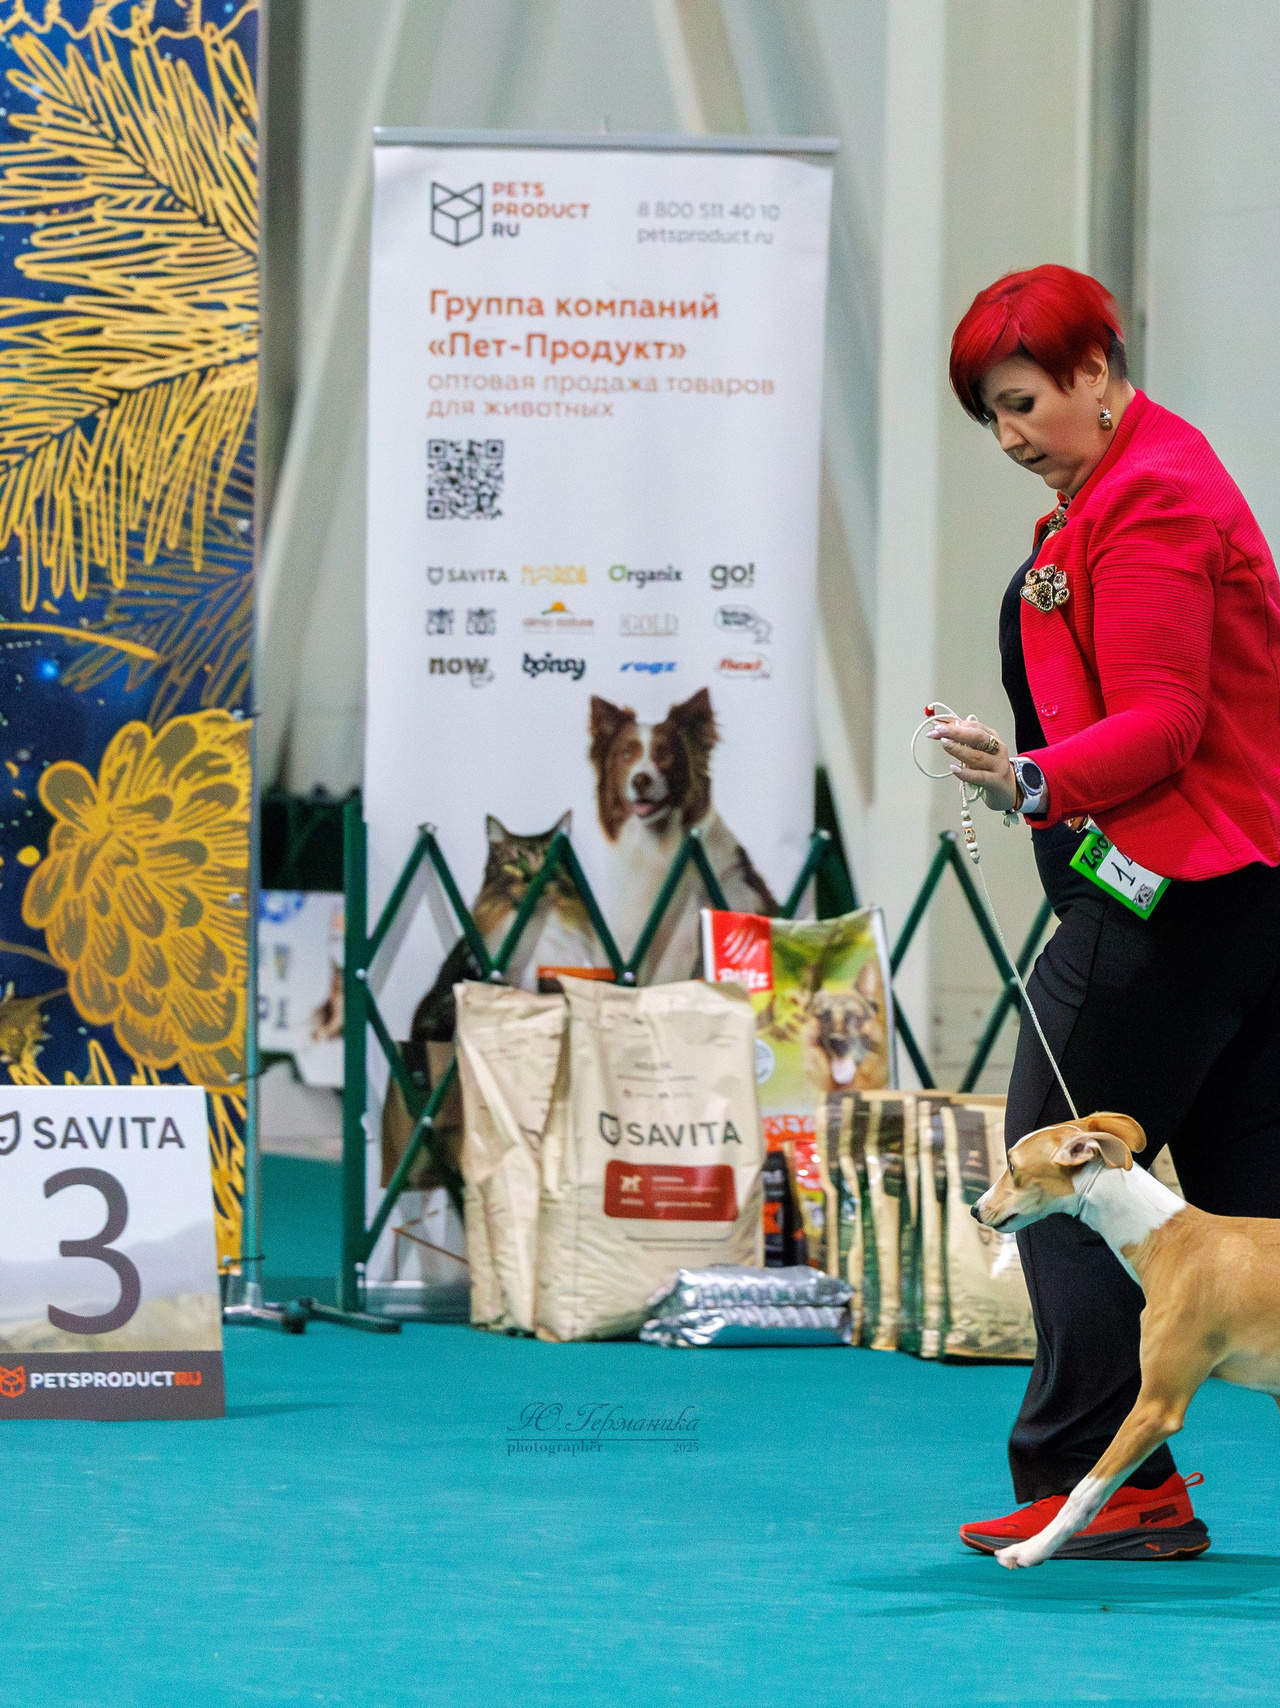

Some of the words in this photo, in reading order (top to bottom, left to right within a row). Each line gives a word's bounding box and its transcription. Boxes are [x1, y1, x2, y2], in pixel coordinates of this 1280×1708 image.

[492, 181, 545, 198] PETS
[492, 202, 590, 219] PRODUCT
[655, 202, 694, 219] 800
[700, 202, 724, 219] 511
[730, 203, 756, 220] 40
[761, 204, 780, 222] 10
[492, 222, 521, 237] RU
[637, 228, 775, 245] petsproduct.ru
[430, 290, 545, 322] Группа
[555, 293, 719, 319] компаний
[429, 332, 687, 365] «Пет-Продукт»
[428, 374, 535, 392] оптовая
[543, 375, 660, 395] продажа
[667, 377, 775, 396] товаров
[427, 401, 475, 419] для
[484, 401, 614, 418] животных
[448, 568, 508, 583] SAVITA
[609, 565, 682, 589] Organix
[710, 562, 755, 590] go!
[33, 1116, 186, 1150] SAVITA
[627, 1122, 742, 1147] SAVITA
[44, 1167, 142, 1335] 3
